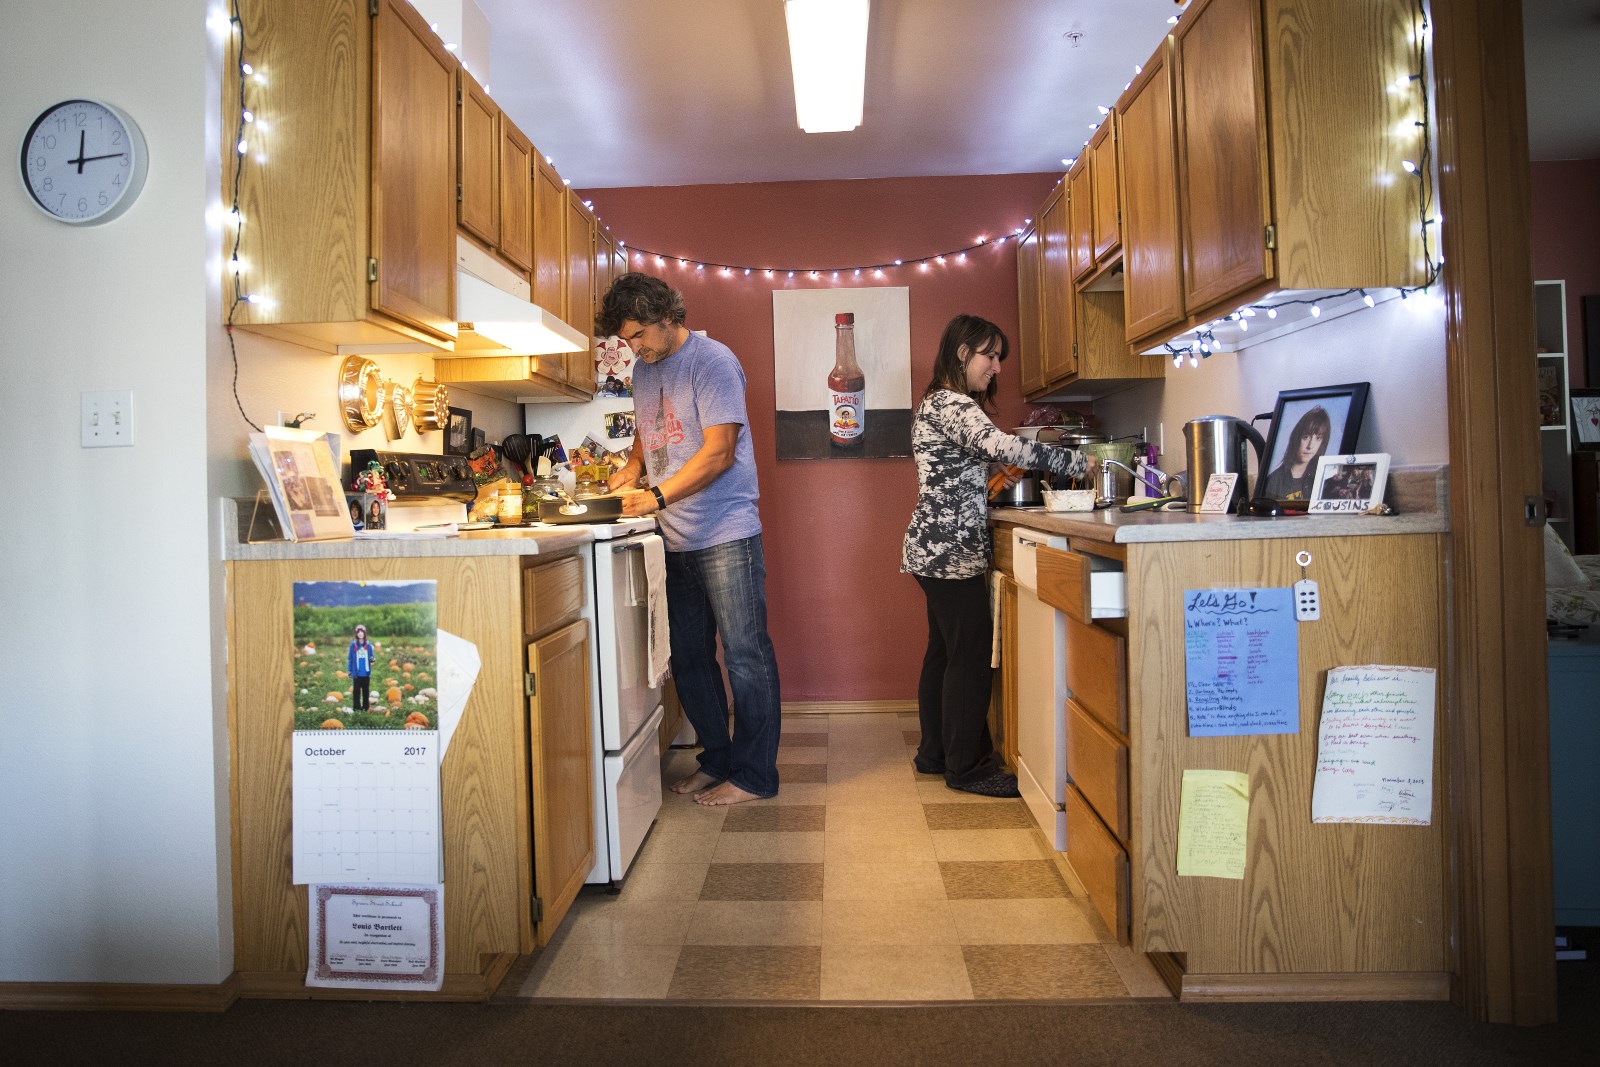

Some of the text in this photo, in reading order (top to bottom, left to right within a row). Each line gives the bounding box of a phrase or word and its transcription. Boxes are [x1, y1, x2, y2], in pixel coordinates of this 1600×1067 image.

[56, 119, 66, 132] 11
[72, 113, 87, 126] 12
[98, 116, 103, 130] 1
[40, 136, 56, 150] 10
[112, 131, 121, 145] 2
[36, 157, 46, 171] 9
[120, 153, 129, 166] 3
[43, 178, 53, 192] 8
[112, 174, 120, 186] 4
[58, 194, 66, 206] 7
[98, 191, 108, 205] 5
[78, 198, 88, 212] 6
[1312, 500, 1370, 510] COUSINS
[1223, 618, 1248, 626] What?
[305, 747, 426, 756] October 2017
